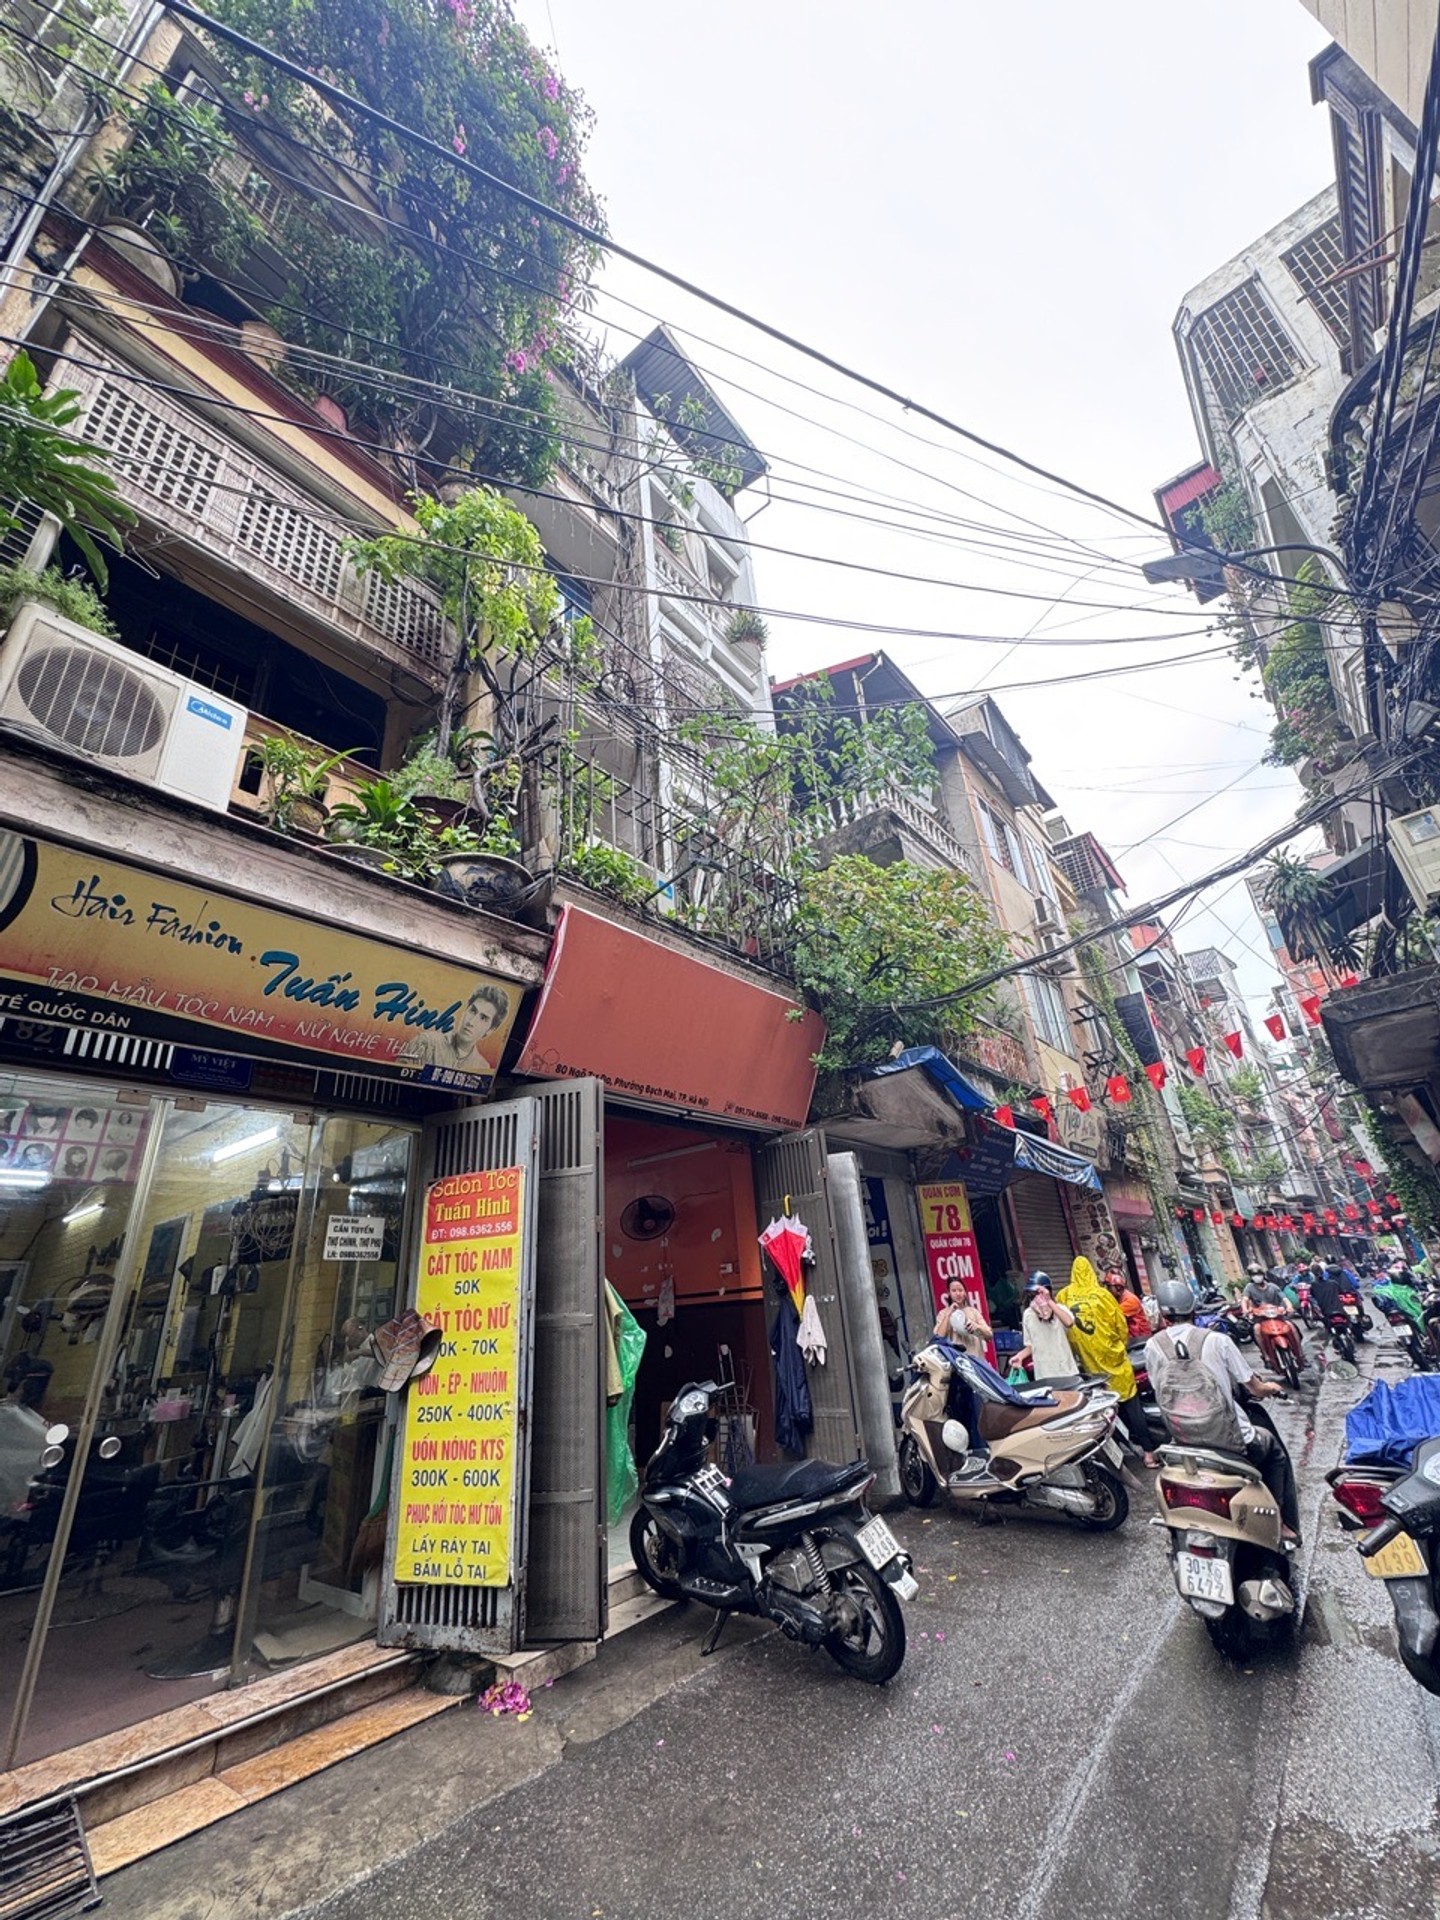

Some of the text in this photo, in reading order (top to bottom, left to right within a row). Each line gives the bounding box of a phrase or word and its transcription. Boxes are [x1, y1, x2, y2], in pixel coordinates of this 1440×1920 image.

[51, 875, 243, 955] Hair Fashion
[260, 950, 360, 1012] Tuấn
[46, 967, 98, 996] TẠO
[104, 976, 163, 1008] MẪU
[175, 991, 219, 1018] TÓC
[222, 1007, 275, 1030] NAM
[28, 1001, 87, 1020] QUỐC
[90, 1012, 131, 1028] DÂN
[16, 1021, 55, 1043] 82
[555, 1063, 568, 1075] 80
[433, 1171, 516, 1198] Salon Tóc
[435, 1195, 510, 1223] Tuấn Hinh
[929, 1204, 961, 1232] 78
[431, 1228, 447, 1240] ĐT:
[962, 1237, 971, 1247] 78
[427, 1246, 513, 1276] CẮT TÓC NAM
[936, 1251, 974, 1279] CƠM
[454, 1279, 480, 1295] 50K
[940, 1291, 981, 1312] SH
[455, 1303, 482, 1332] TÓC
[487, 1301, 511, 1329] NỮ
[472, 1338, 498, 1355] 70K
[448, 1368, 462, 1395] ÉP
[470, 1367, 507, 1397] NHUỘM
[417, 1405, 453, 1422] 250K
[467, 1403, 504, 1421] 400K
[412, 1433, 505, 1461] UỐN NÓNG KTS
[411, 1469, 448, 1487] 300K
[463, 1469, 501, 1487] 600K
[405, 1503, 430, 1528] PHỤC
[450, 1499, 467, 1524] TÓC
[412, 1533, 491, 1555] LẤY RÁY TAI
[413, 1557, 440, 1577] BẤM
[467, 1564, 486, 1579] TAI
